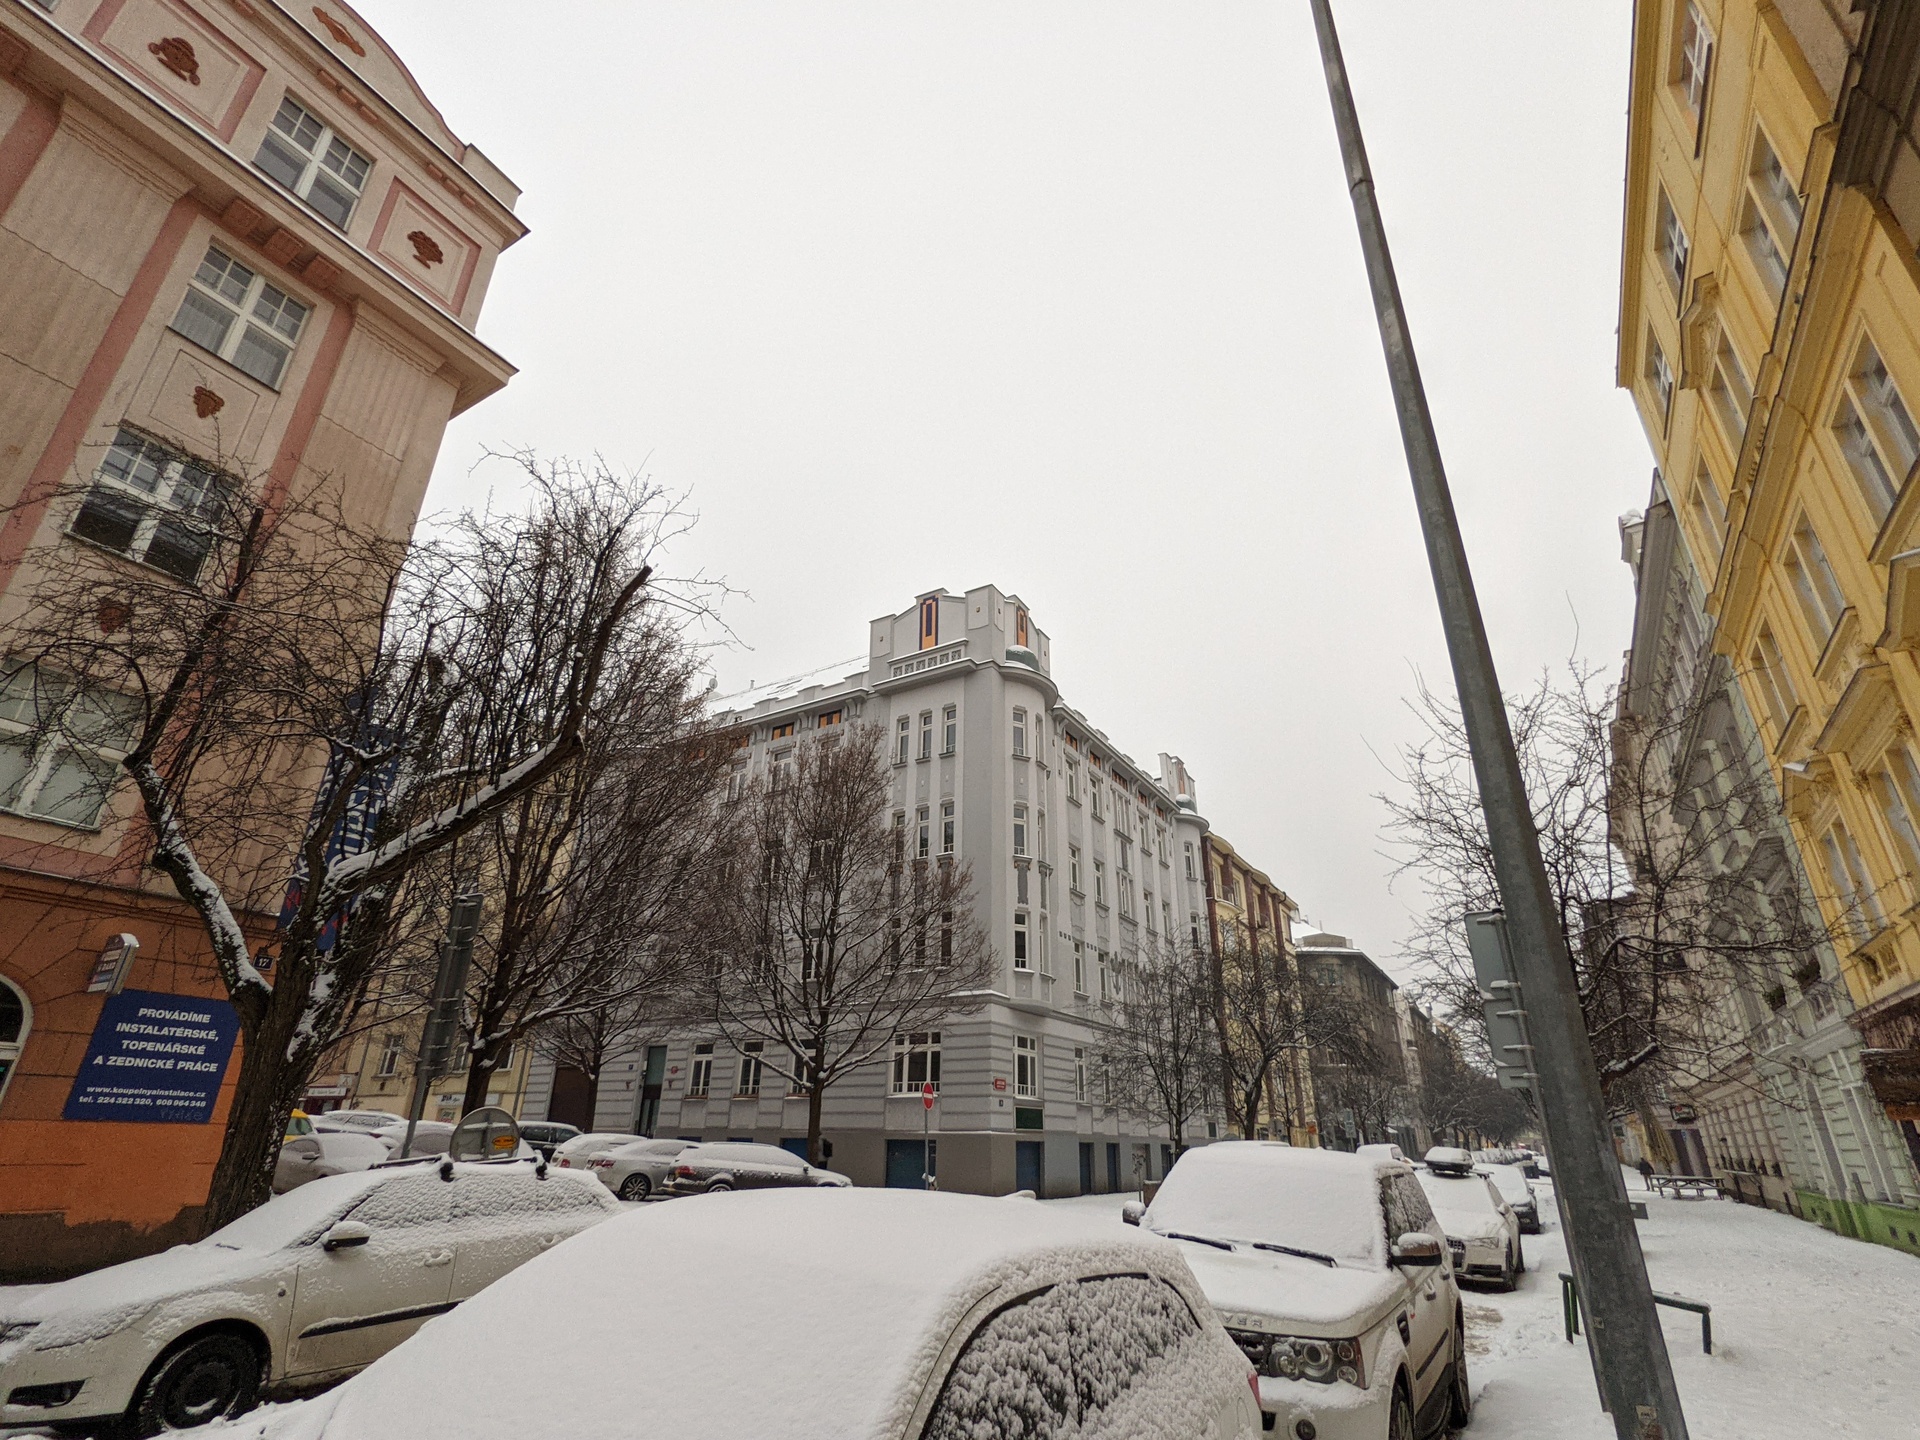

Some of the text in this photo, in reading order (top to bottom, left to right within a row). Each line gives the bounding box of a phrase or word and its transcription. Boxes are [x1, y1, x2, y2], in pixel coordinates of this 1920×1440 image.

[258, 957, 270, 968] 17
[138, 1007, 211, 1023] PROVÁDÍME
[115, 1022, 219, 1042] INSTALATÉRSKÉ,
[121, 1040, 206, 1055] TOPENÁŘSKÉ
[92, 1055, 219, 1072] A ZEDNICKÉ PRÁCE
[78, 1095, 94, 1103] tel.
